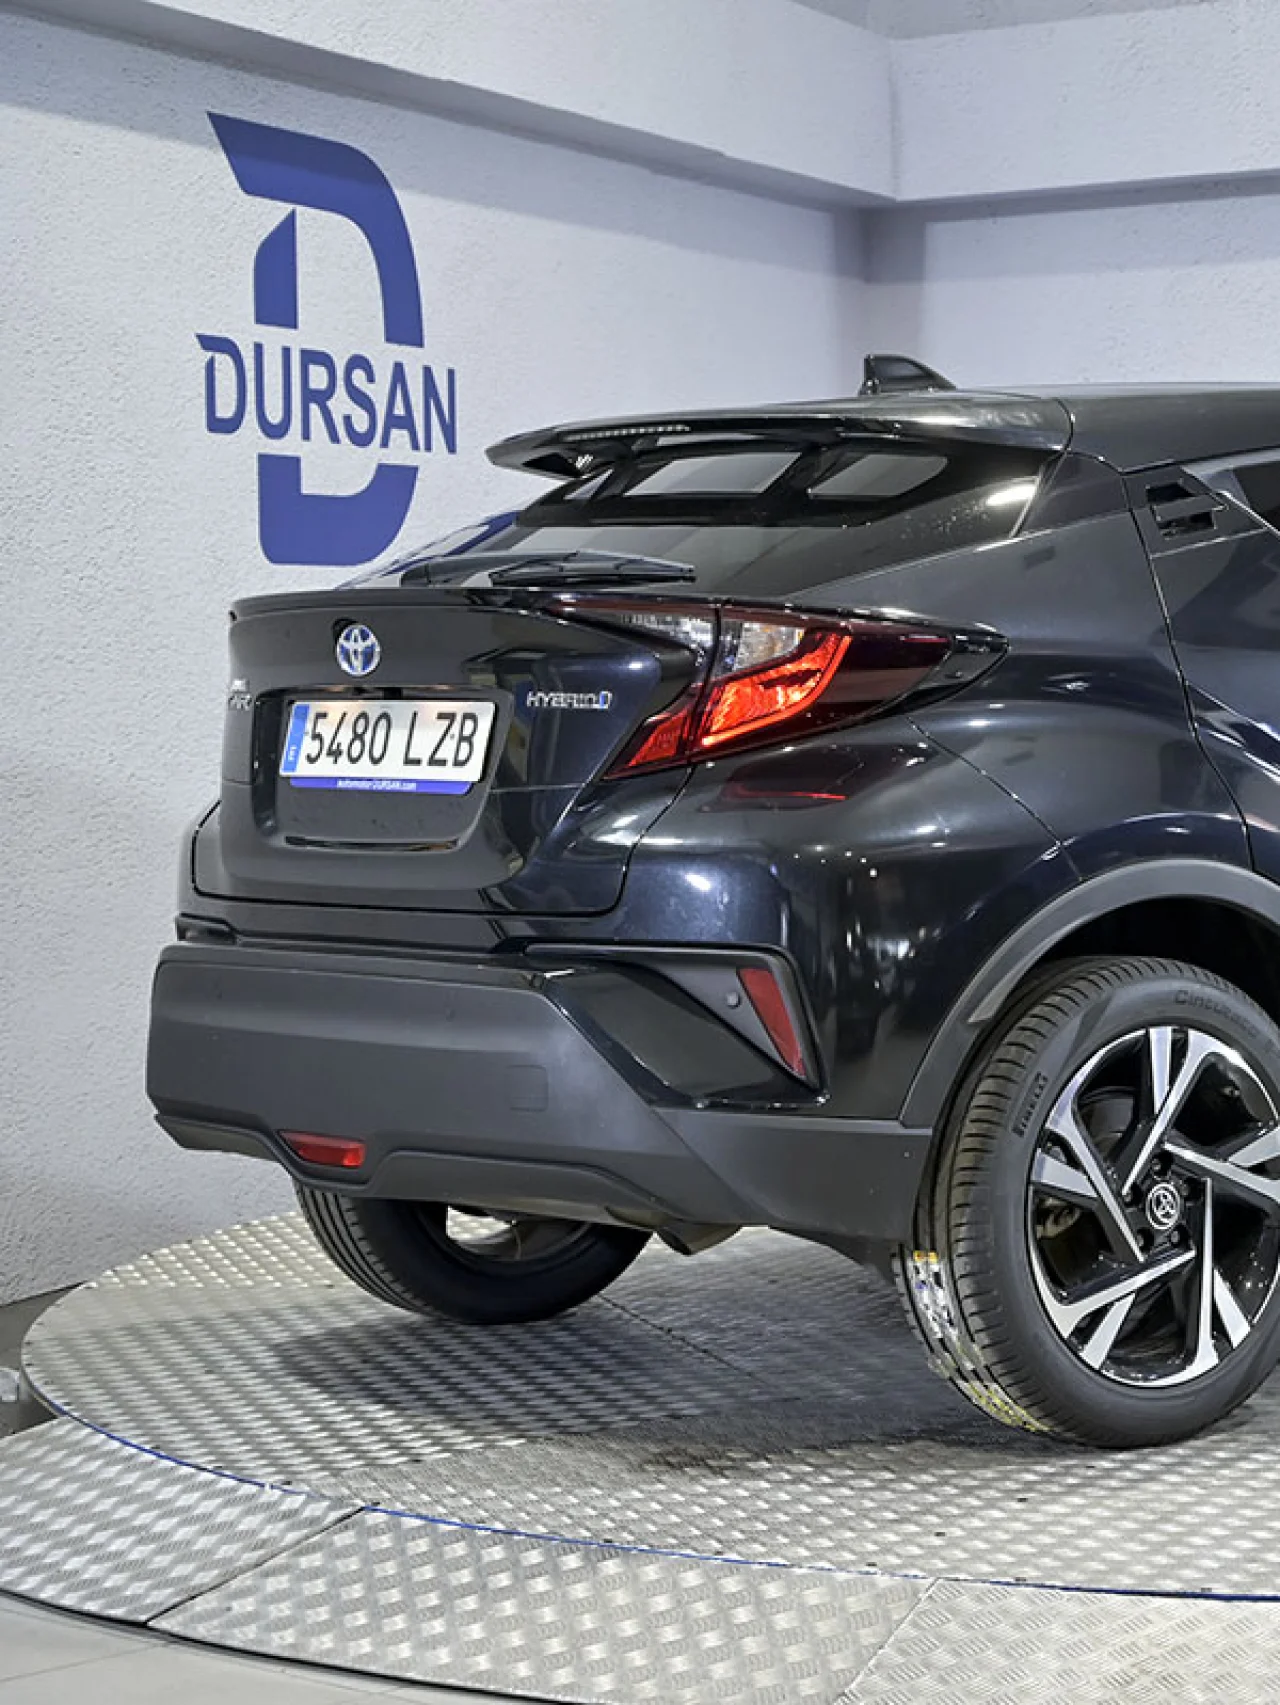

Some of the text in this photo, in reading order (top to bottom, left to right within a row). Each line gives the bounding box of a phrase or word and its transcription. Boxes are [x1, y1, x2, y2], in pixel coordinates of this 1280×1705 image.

[196, 333, 457, 454] DURSAN
[305, 712, 391, 764] 5480
[403, 713, 478, 768] LZB
